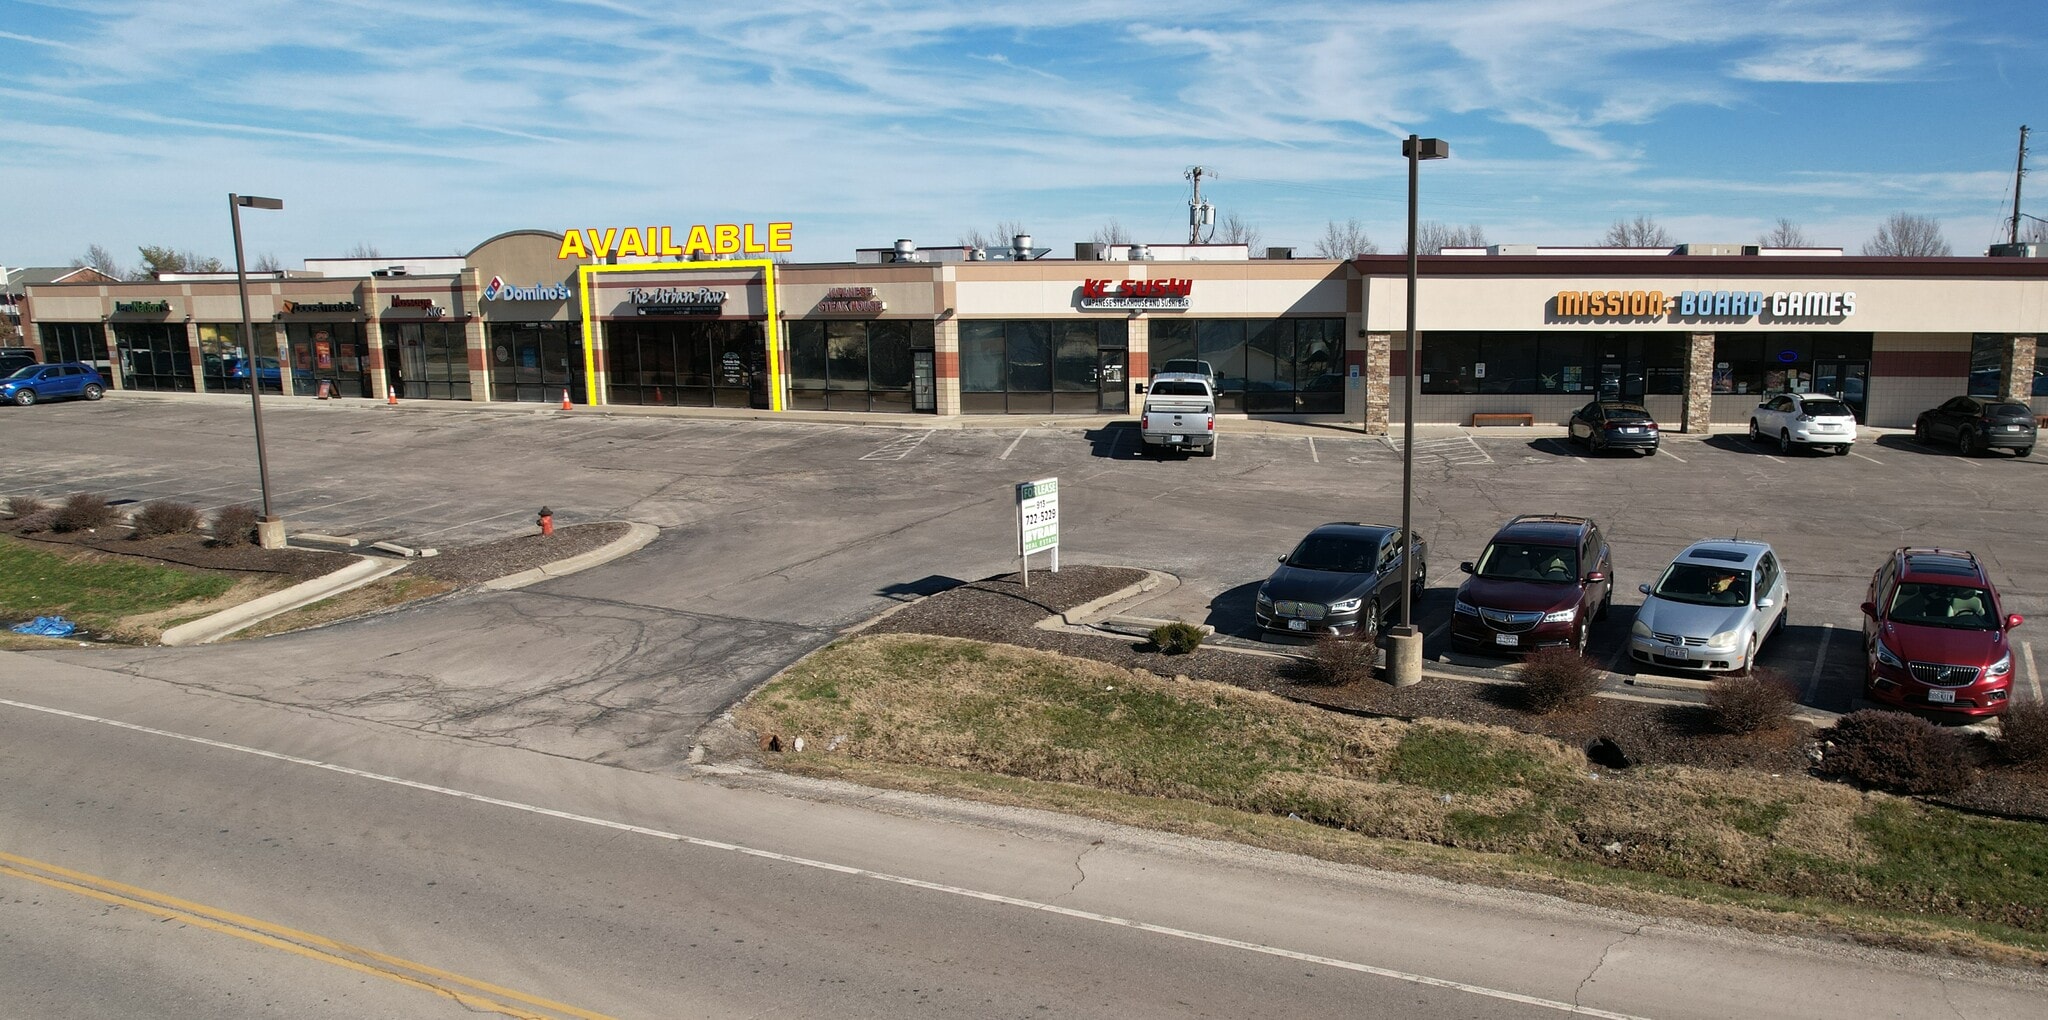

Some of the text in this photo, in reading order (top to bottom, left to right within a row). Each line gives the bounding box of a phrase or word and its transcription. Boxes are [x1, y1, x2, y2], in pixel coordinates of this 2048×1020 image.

[503, 283, 569, 301] Domino's
[628, 287, 726, 305] The Urban Paw
[827, 287, 874, 298] JAPANESE
[1083, 278, 1193, 297] KC SUSHI
[817, 301, 884, 312] STEAK HOUSE
[1085, 298, 1190, 307] JAPANESE STEAKHOUSE AND SUSHI BAR
[1680, 290, 1764, 316] BOARD
[1772, 290, 1857, 317] GAMES
[1023, 482, 1057, 499] FOR LEASE
[1025, 508, 1057, 525] 722-5229
